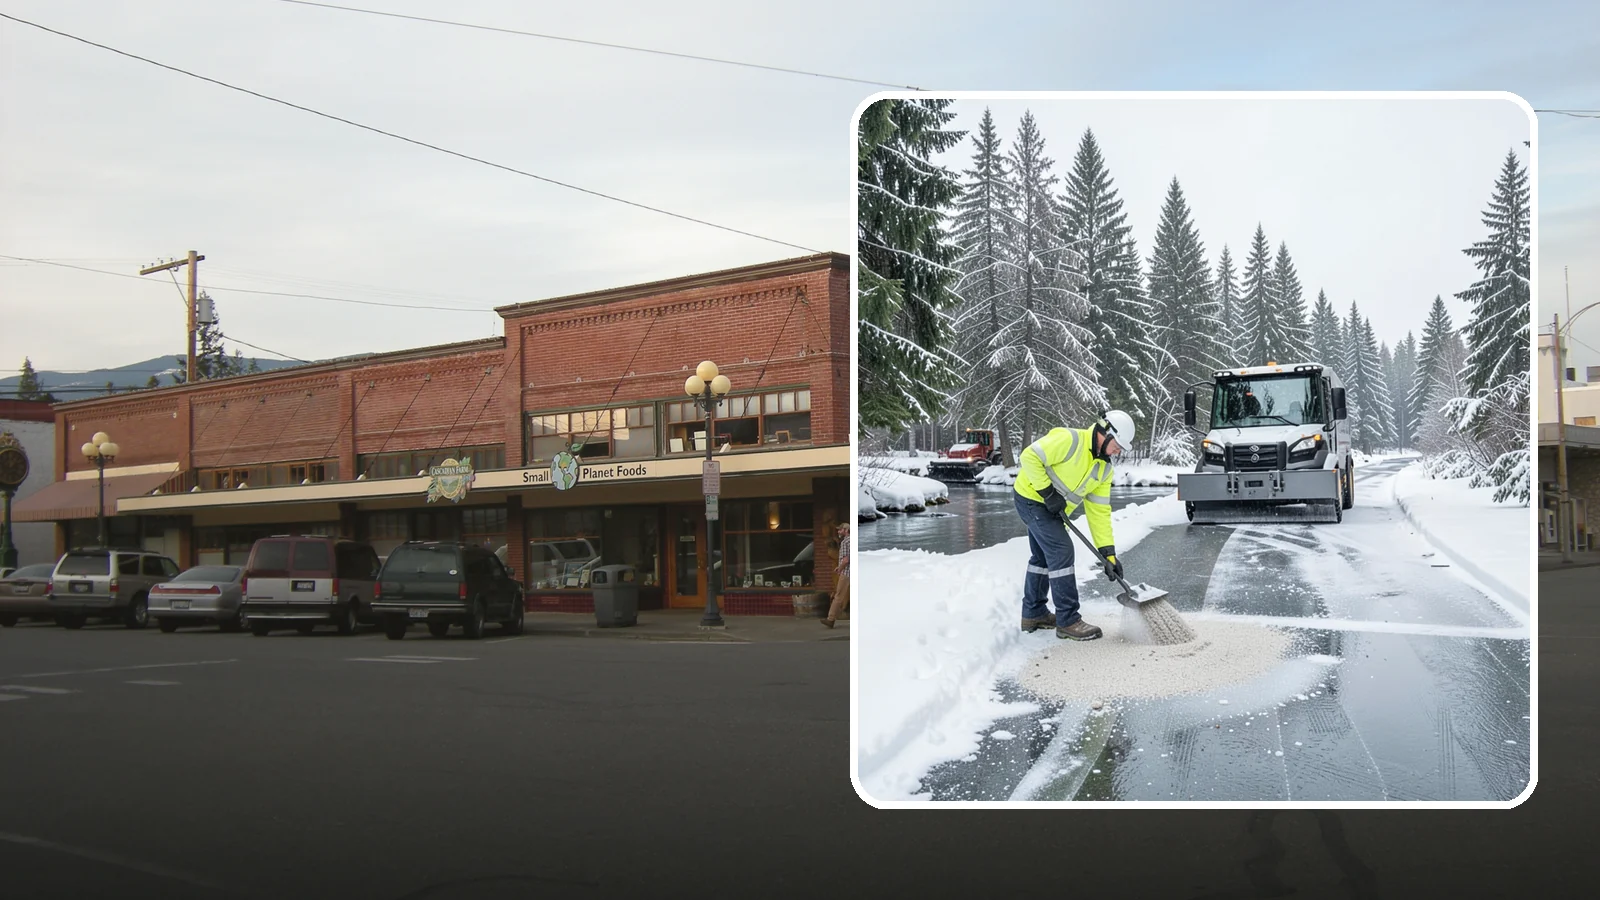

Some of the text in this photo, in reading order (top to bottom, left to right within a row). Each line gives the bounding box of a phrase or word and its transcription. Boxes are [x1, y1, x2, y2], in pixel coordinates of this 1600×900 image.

[523, 464, 647, 483] Small Planet Foods
